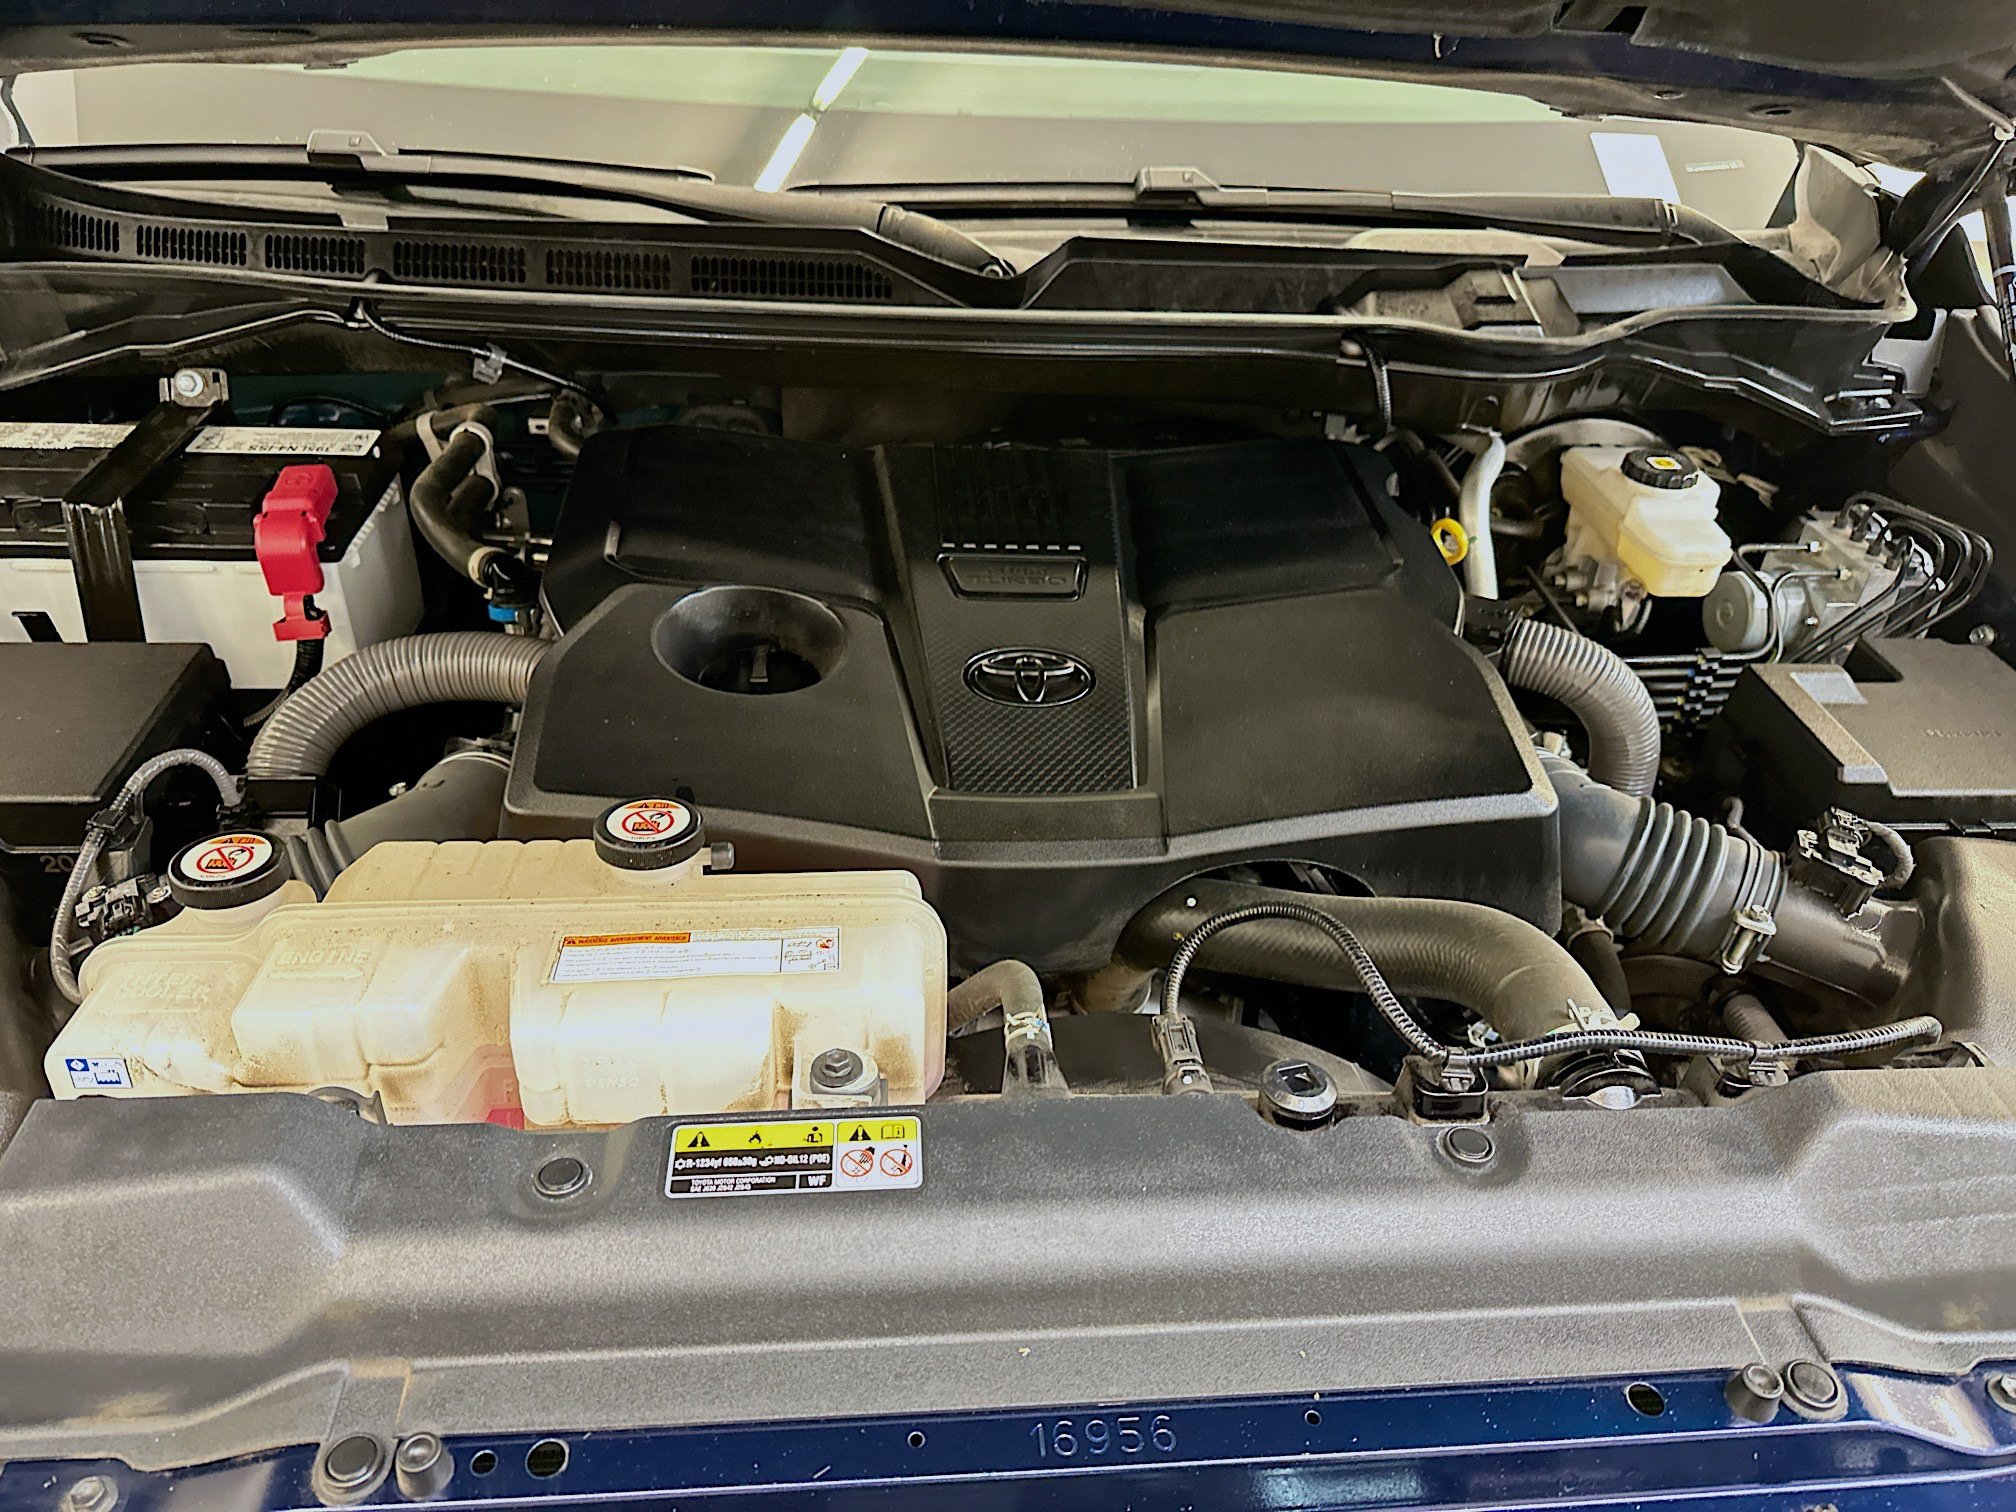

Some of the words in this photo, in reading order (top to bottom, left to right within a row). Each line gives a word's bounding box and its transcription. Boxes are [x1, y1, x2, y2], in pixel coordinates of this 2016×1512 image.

[39, 854, 75, 873] 20
[276, 950, 371, 965] ENGINE
[690, 1178, 714, 1186] TOYOTA
[714, 1177, 735, 1185] MOTOR
[736, 1176, 776, 1184] CORPORATION
[807, 1175, 826, 1187] WF
[1029, 1414, 1177, 1458] 16956
